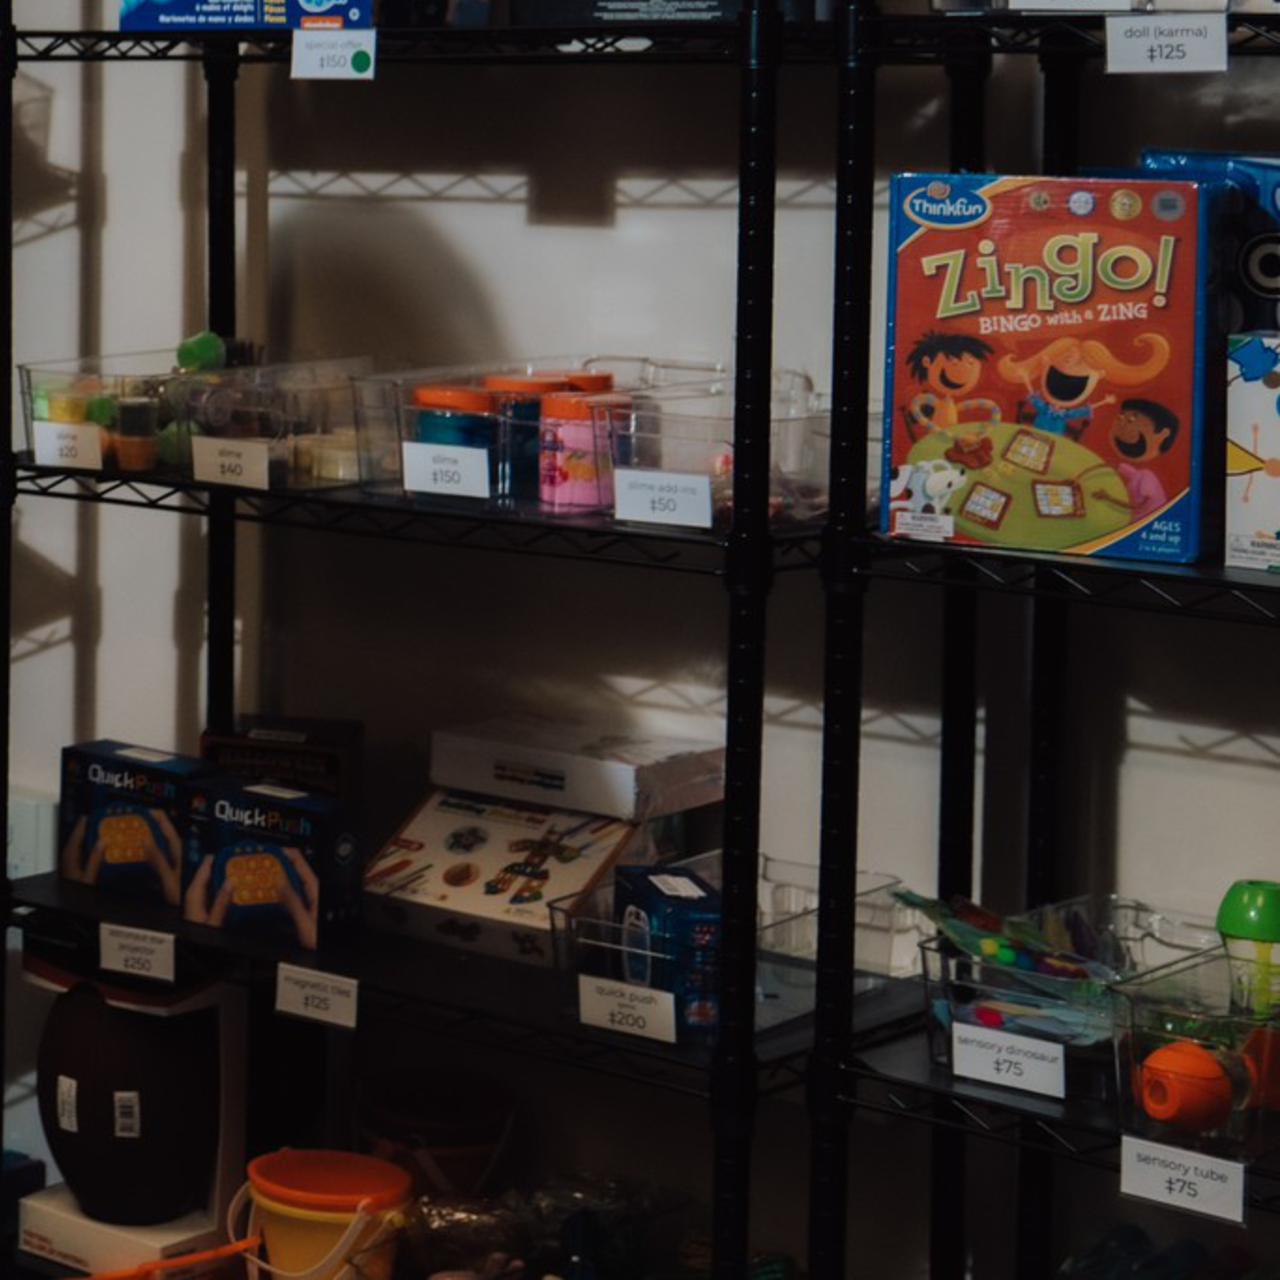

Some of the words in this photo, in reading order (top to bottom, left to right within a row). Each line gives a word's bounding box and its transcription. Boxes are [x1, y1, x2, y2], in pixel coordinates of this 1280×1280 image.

[1124, 26, 1150, 39] doll
[1153, 25, 1209, 40] (karma)
[921, 231, 1178, 320] Zingo!
[978, 311, 1042, 336] BINGO
[1045, 309, 1084, 328] with
[1084, 310, 1094, 320] a
[1096, 301, 1149, 323] ZING
[431, 454, 459, 466] slime
[214, 799, 312, 838] QuickPush
[594, 984, 628, 1000] quick
[628, 992, 659, 1007] push
[956, 1034, 1005, 1054] sensory
[1006, 1042, 1060, 1065] dinosaur
[1135, 1150, 1192, 1179] sensory
[1193, 1165, 1229, 1185] tube
